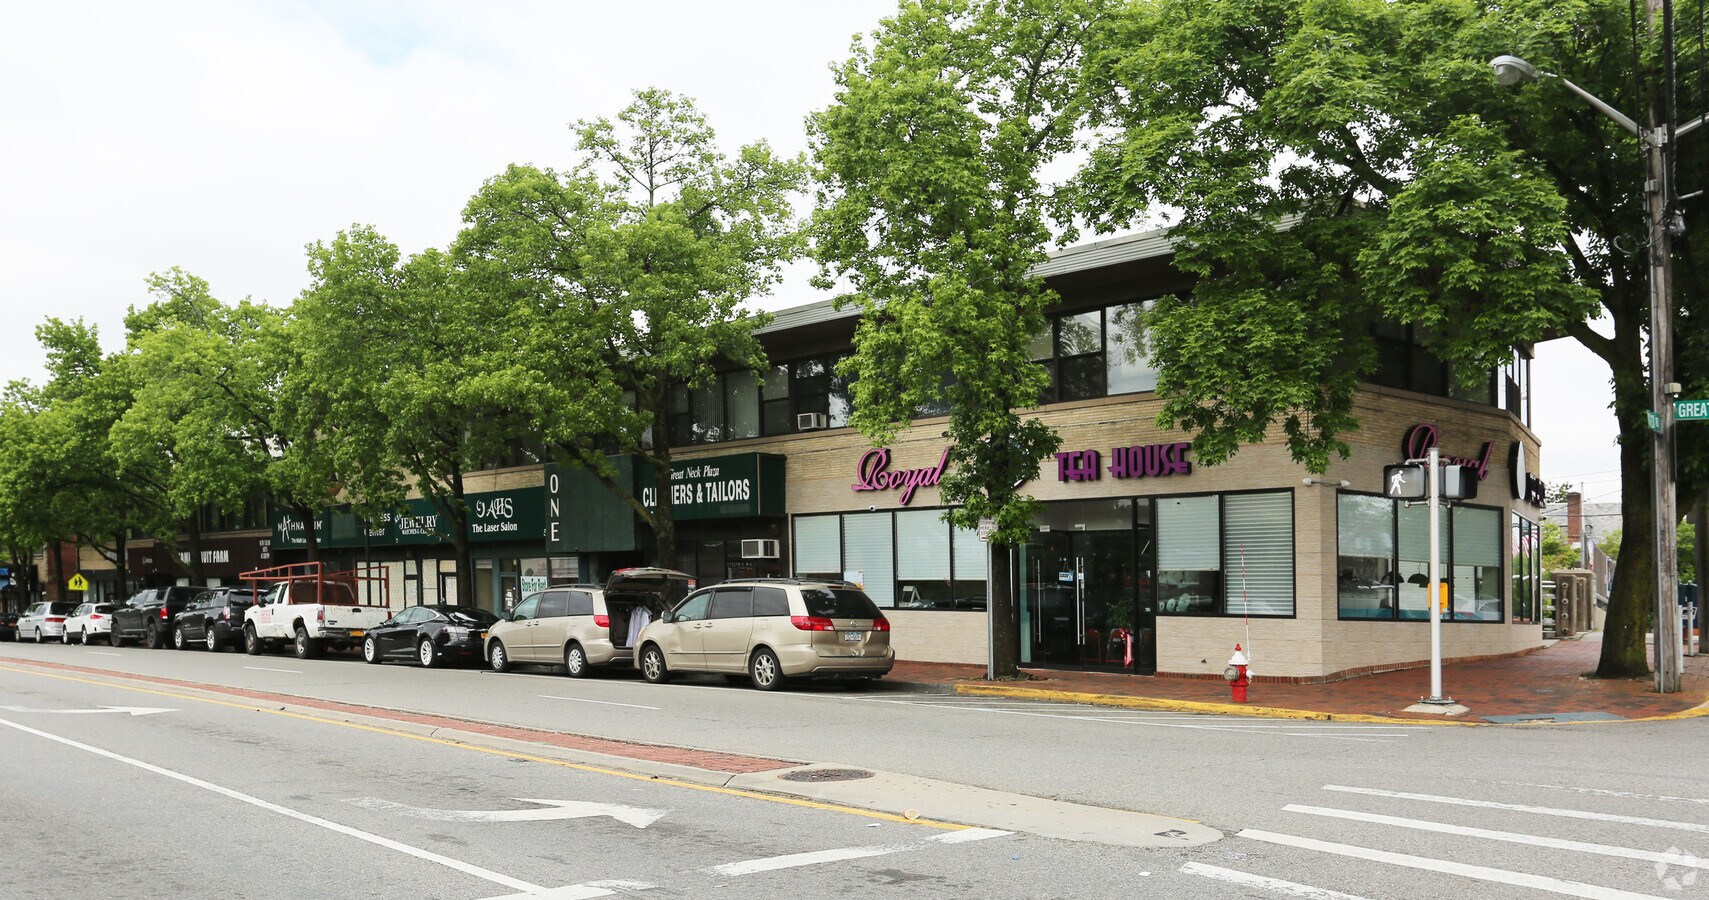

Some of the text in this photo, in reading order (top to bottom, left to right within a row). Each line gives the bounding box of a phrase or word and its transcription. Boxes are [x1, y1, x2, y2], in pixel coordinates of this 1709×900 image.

[685, 466, 702, 479] Neck
[703, 465, 720, 478] Plaza
[851, 447, 950, 505] Royal
[1055, 442, 1189, 482] TEA HOUSE
[642, 478, 750, 507] CLERS & TAILORS
[277, 514, 323, 543] MATHNAUM
[472, 522, 518, 533] The Laser Salon
